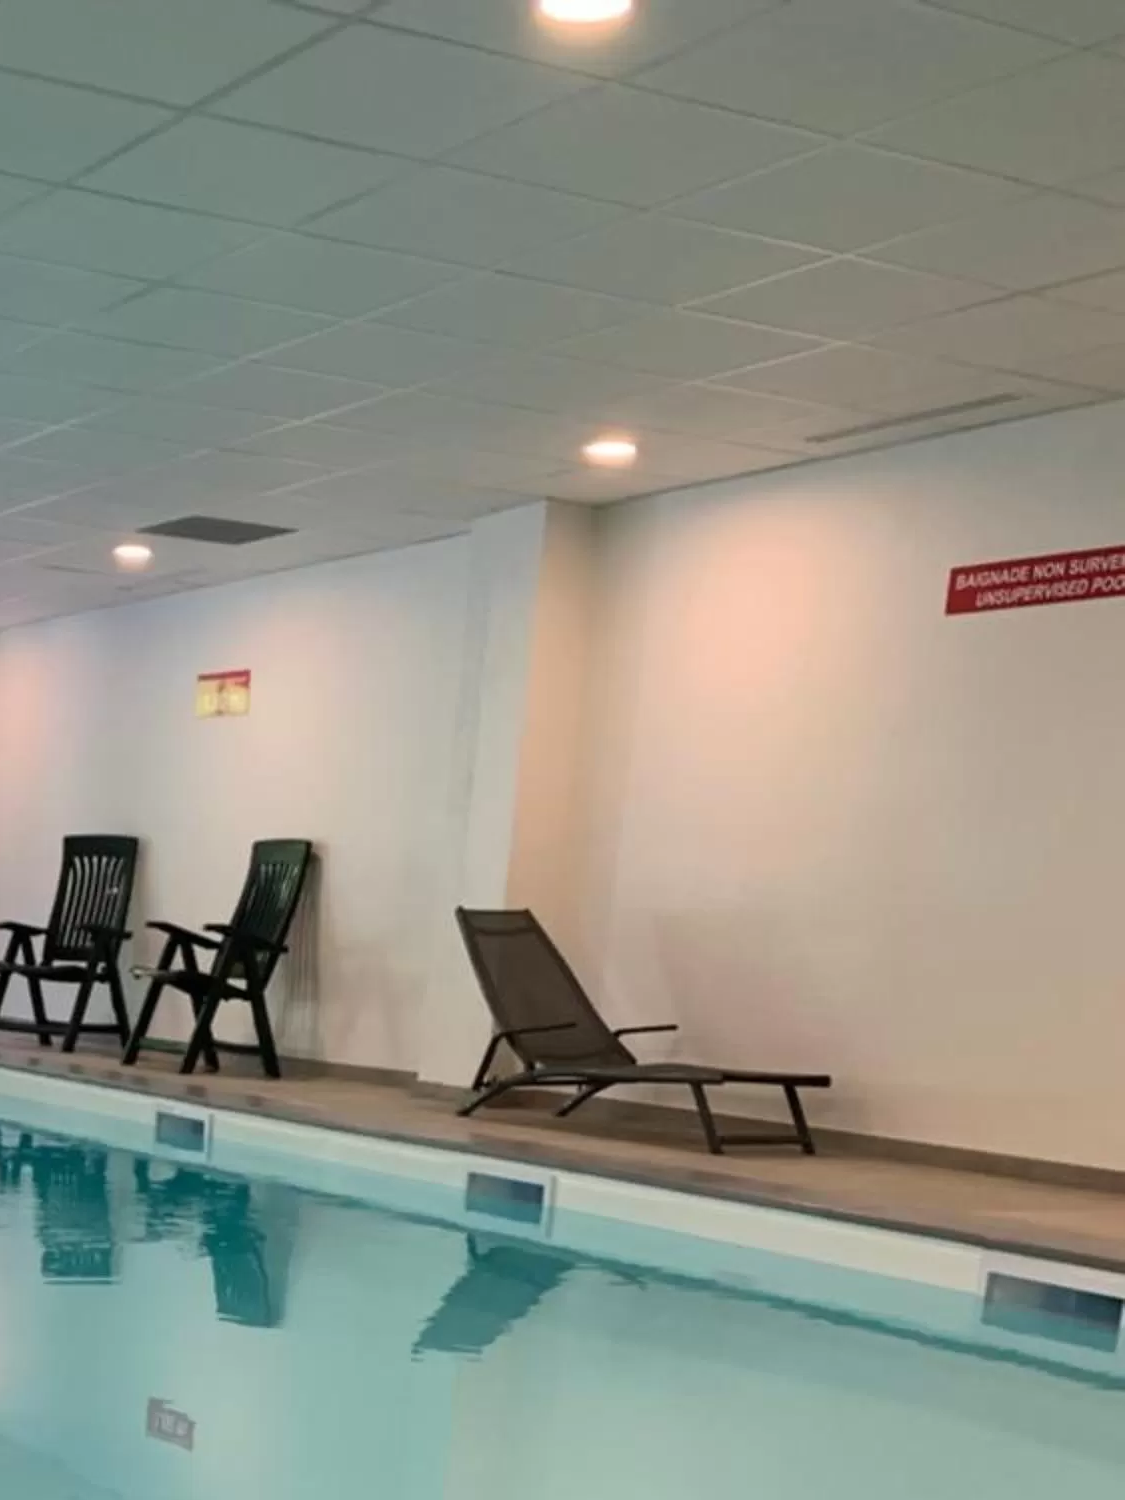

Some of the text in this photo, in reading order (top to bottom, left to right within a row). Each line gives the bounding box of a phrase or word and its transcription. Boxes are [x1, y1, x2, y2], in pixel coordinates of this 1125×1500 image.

[955, 566, 1031, 591] BAIGNADE
[1033, 562, 1065, 580] NON
[975, 579, 1089, 607] UNSUPERVISED
